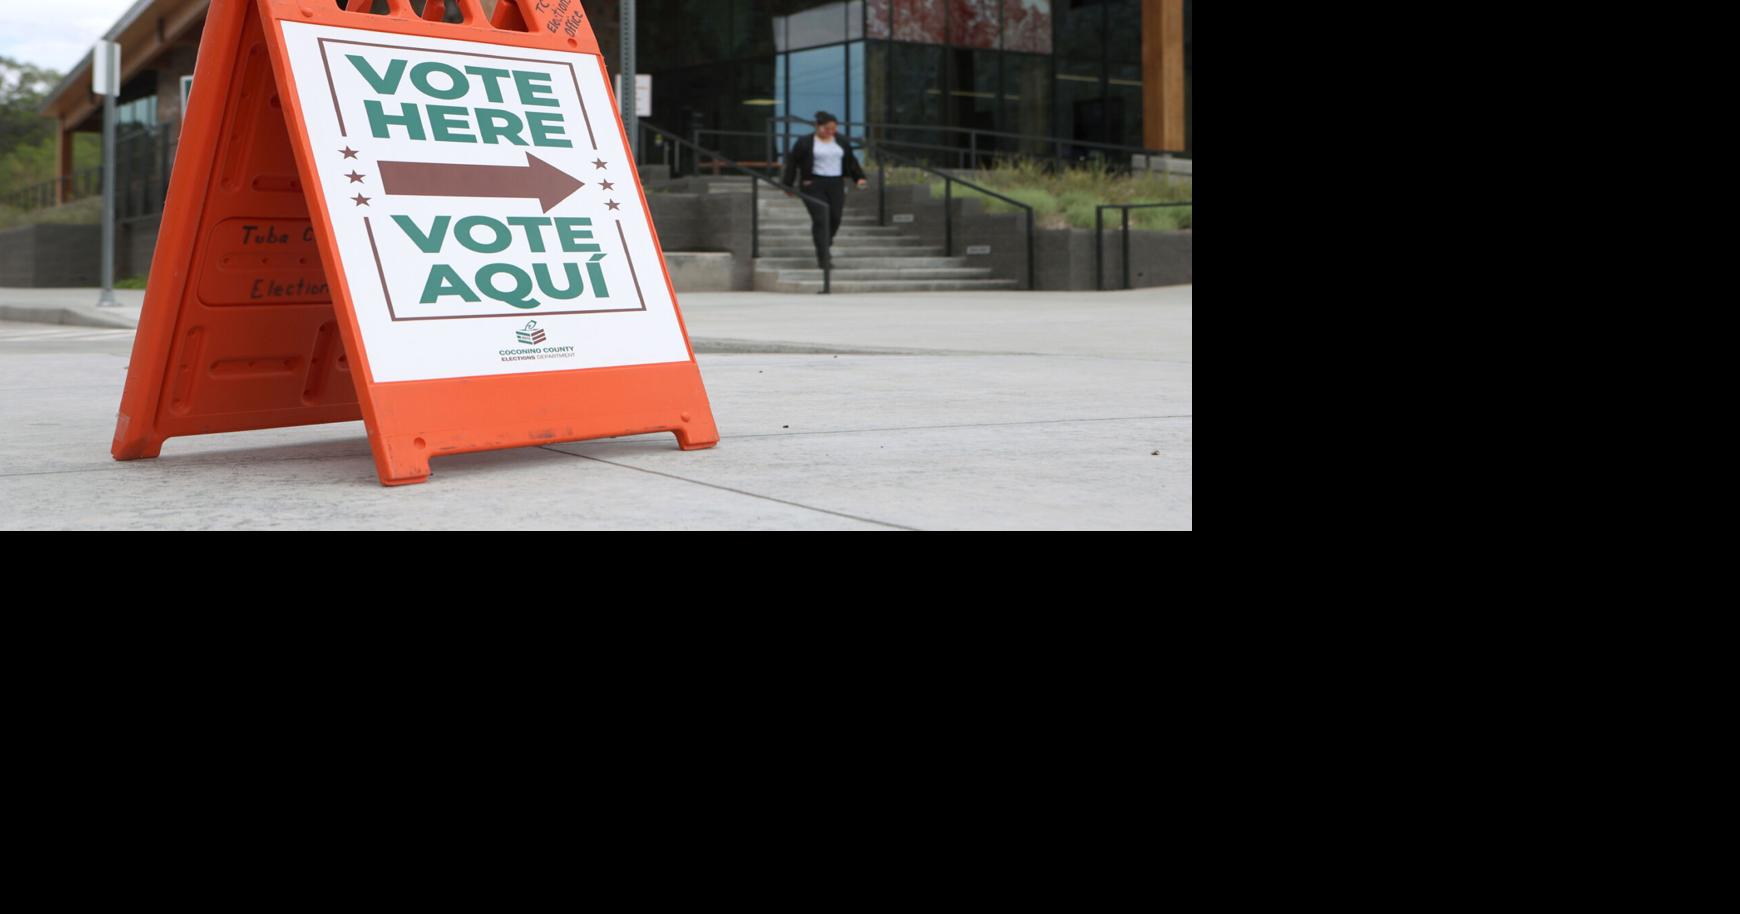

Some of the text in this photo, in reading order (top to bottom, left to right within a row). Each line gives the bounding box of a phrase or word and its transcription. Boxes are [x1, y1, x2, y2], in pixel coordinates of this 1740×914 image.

[344, 54, 560, 108] VOTE
[363, 99, 574, 149] HERE
[390, 214, 602, 254] VOTE
[418, 253, 610, 310] AQUÍ
[499, 348, 541, 356] COCONINO
